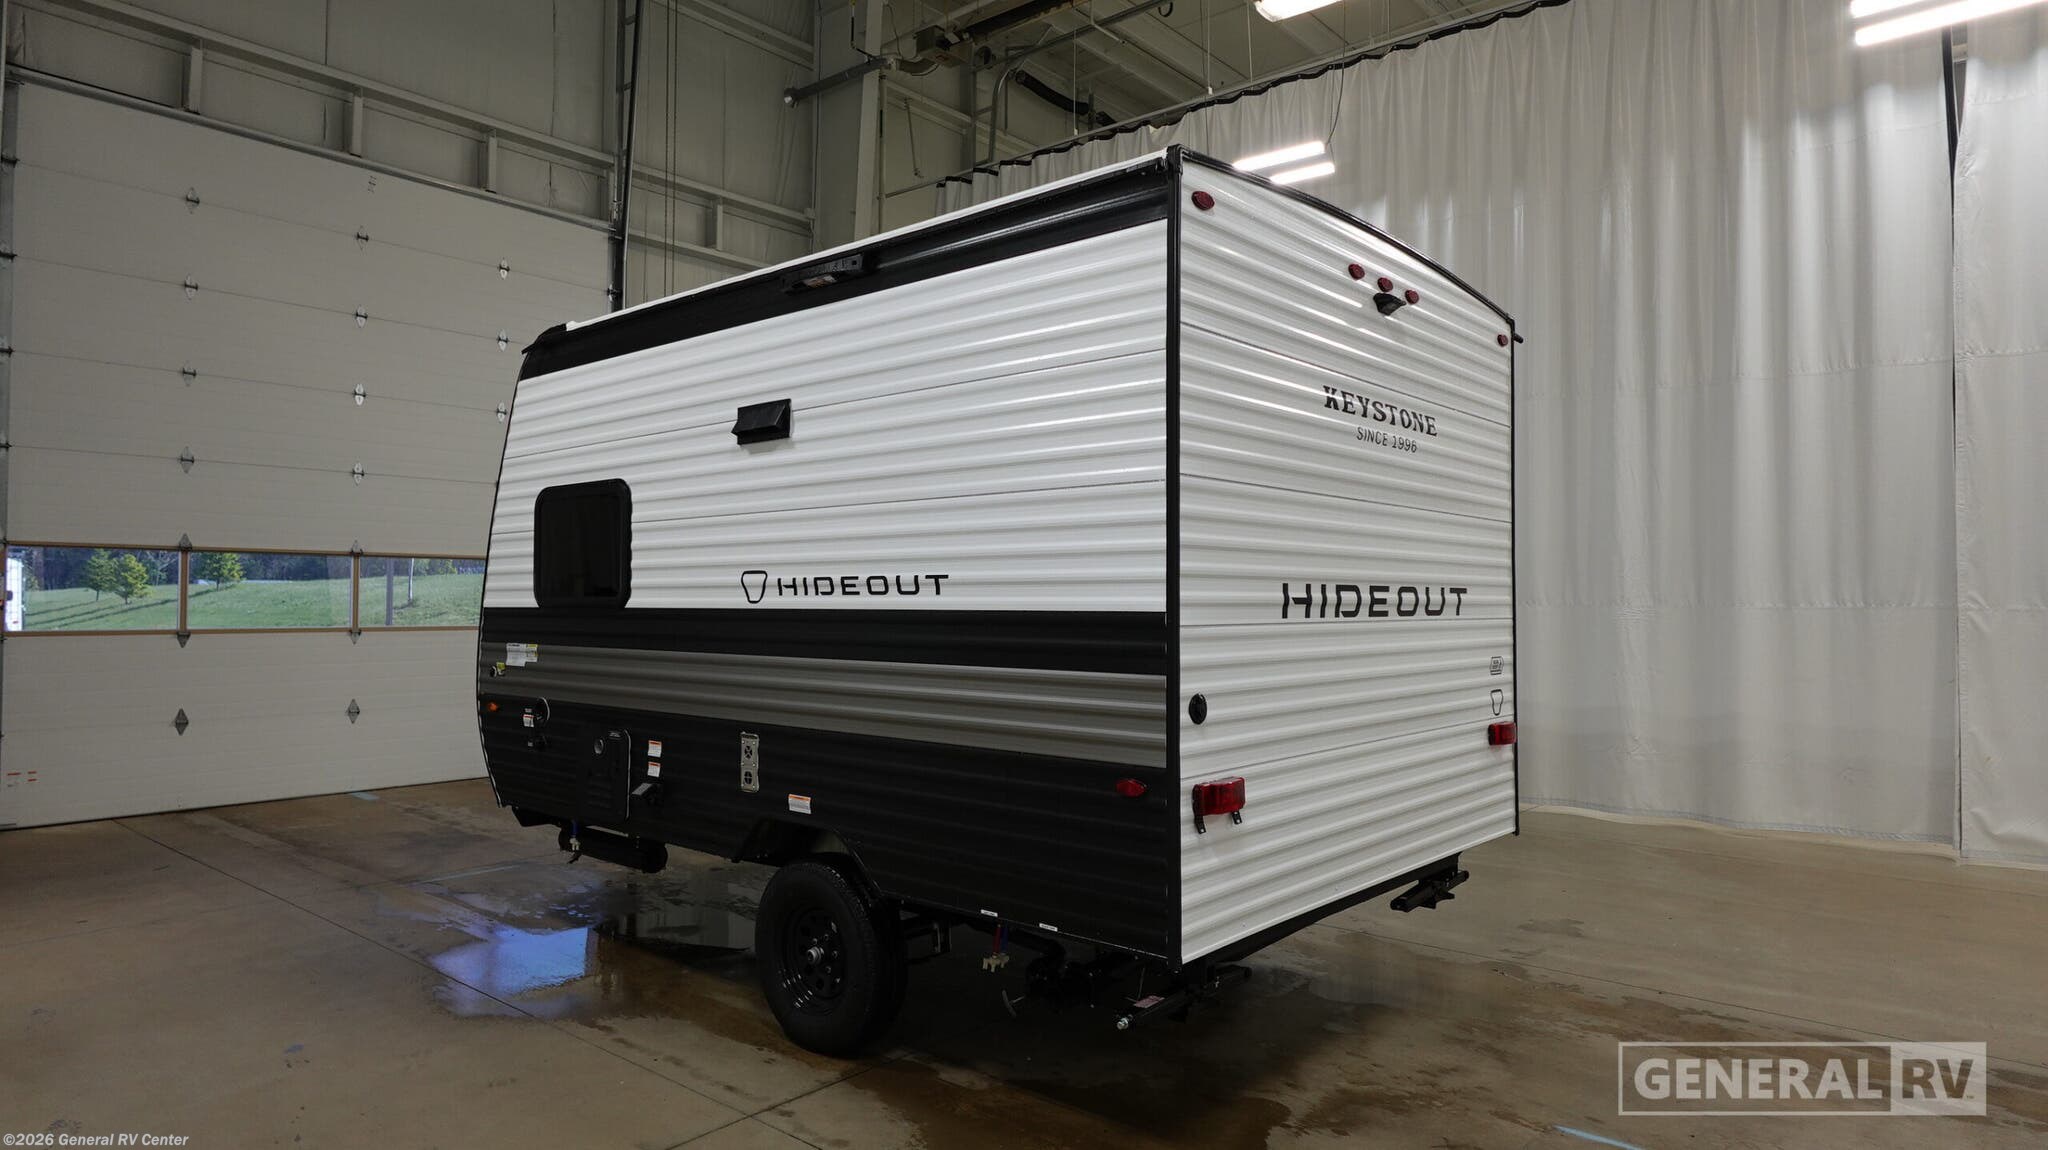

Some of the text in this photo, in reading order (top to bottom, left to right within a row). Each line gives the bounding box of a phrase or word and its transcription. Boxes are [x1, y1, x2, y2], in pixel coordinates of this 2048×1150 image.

[1323, 385, 1438, 437] KEYSTONE
[1356, 426, 1418, 453] SINCE 1996
[778, 574, 949, 597] HIDEOUT
[1281, 582, 1468, 619] HIDEOUT
